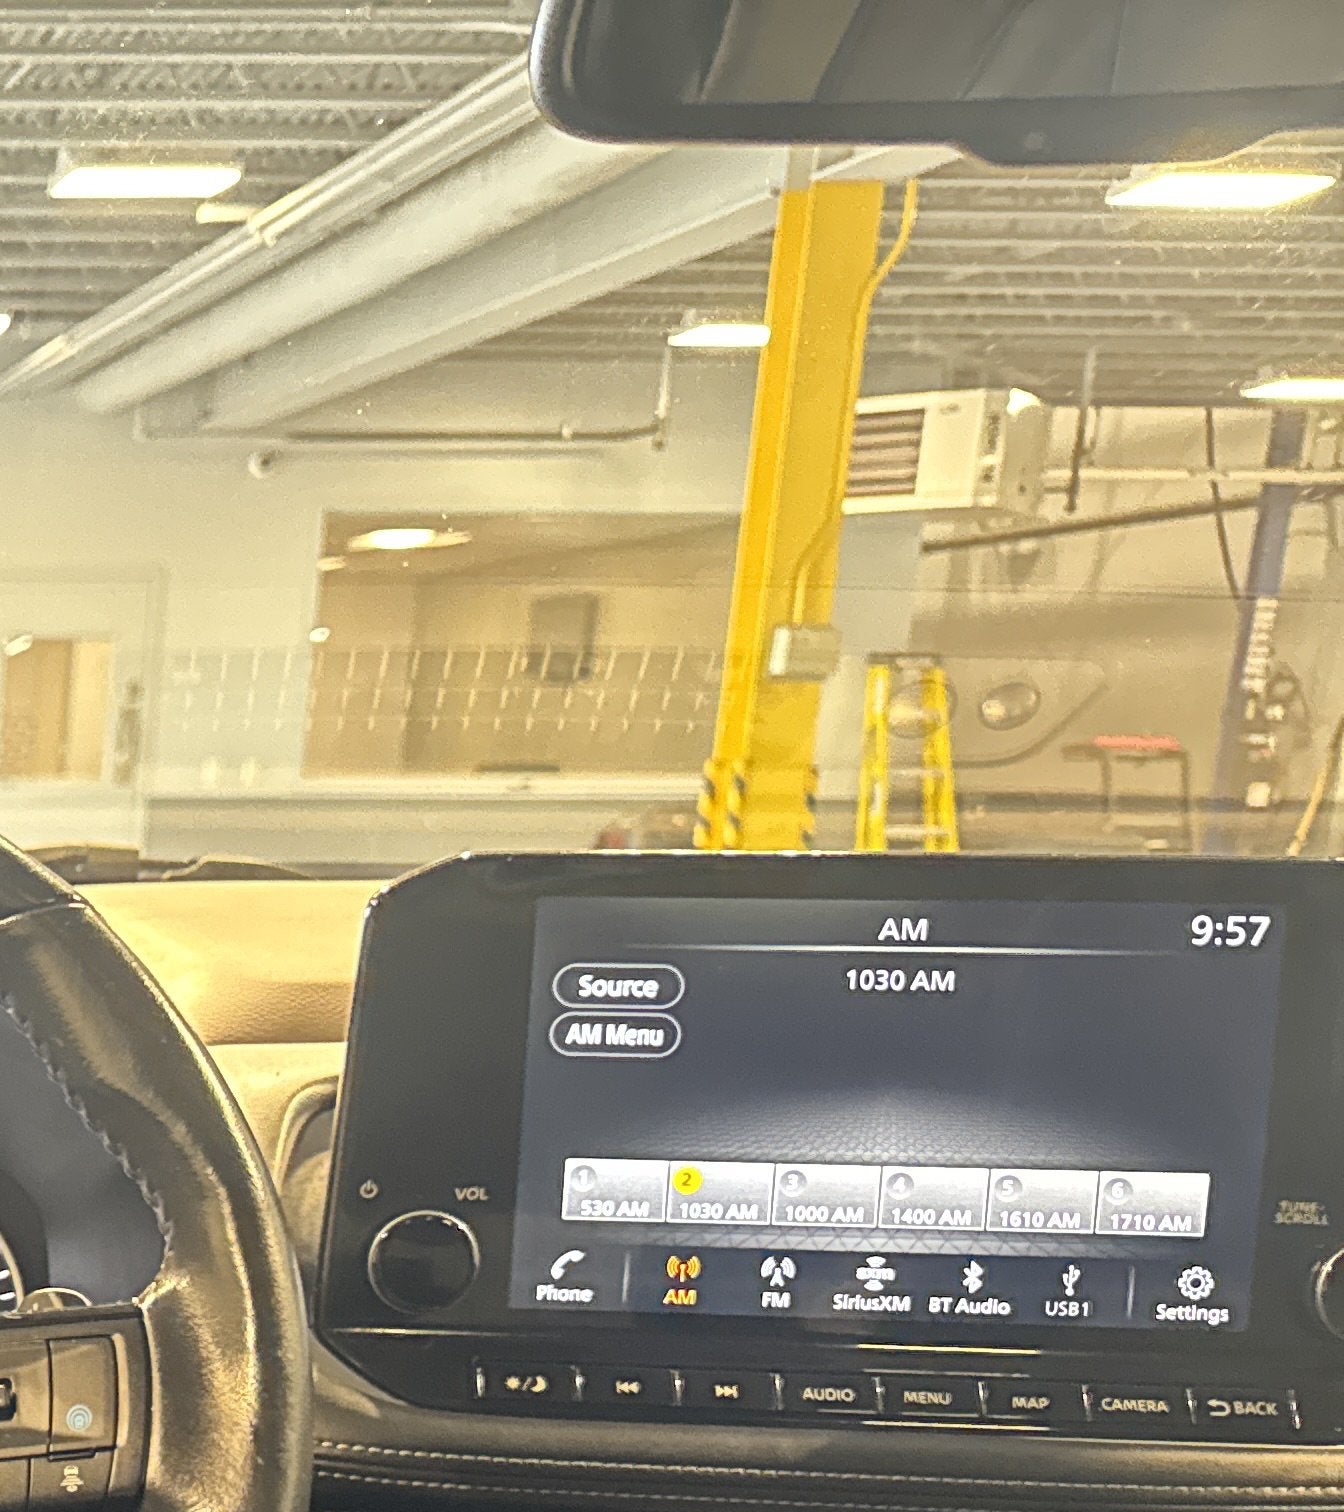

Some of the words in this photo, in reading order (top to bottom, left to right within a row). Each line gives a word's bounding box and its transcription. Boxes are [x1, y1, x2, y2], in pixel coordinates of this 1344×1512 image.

[877, 917, 929, 942] AM
[1190, 914, 1272, 947] 9:57
[577, 974, 660, 999] Source
[845, 969, 906, 992] 1030
[910, 970, 956, 992] AM
[564, 1022, 602, 1046] AM
[605, 1023, 665, 1047] Menu
[577, 1169, 589, 1185] 1
[681, 1173, 693, 1187] 2
[787, 1173, 799, 1190] 3
[893, 1177, 907, 1193] 4
[454, 1186, 489, 1201] VOL
[1001, 1179, 1014, 1196] 5
[1111, 1181, 1124, 1198] 6
[580, 1199, 614, 1217] 530
[616, 1201, 650, 1218] AM
[679, 1202, 723, 1219] 1030
[725, 1204, 759, 1220] AM
[785, 1204, 829, 1222] 1000
[831, 1206, 865, 1223] AM
[891, 1208, 936, 1225] 1400
[938, 1209, 972, 1226] AM
[999, 1210, 1045, 1228] 1610
[1047, 1211, 1081, 1229] AM
[1111, 1213, 1155, 1231] 1710
[1158, 1214, 1192, 1232] AM
[535, 1284, 595, 1303] Phone
[662, 1289, 698, 1306] AM
[761, 1291, 791, 1309] FM
[832, 1293, 912, 1312] SiriusXM
[928, 1297, 953, 1314] BT
[955, 1297, 1012, 1316] Audio
[1045, 1300, 1090, 1318] USB1
[1155, 1303, 1230, 1325] Settings
[801, 1386, 857, 1404] AUDIO
[903, 1389, 953, 1406] MENU
[1011, 1395, 1051, 1411] MAP
[1100, 1397, 1170, 1414] CAMERA
[1233, 1400, 1279, 1418] BACK
